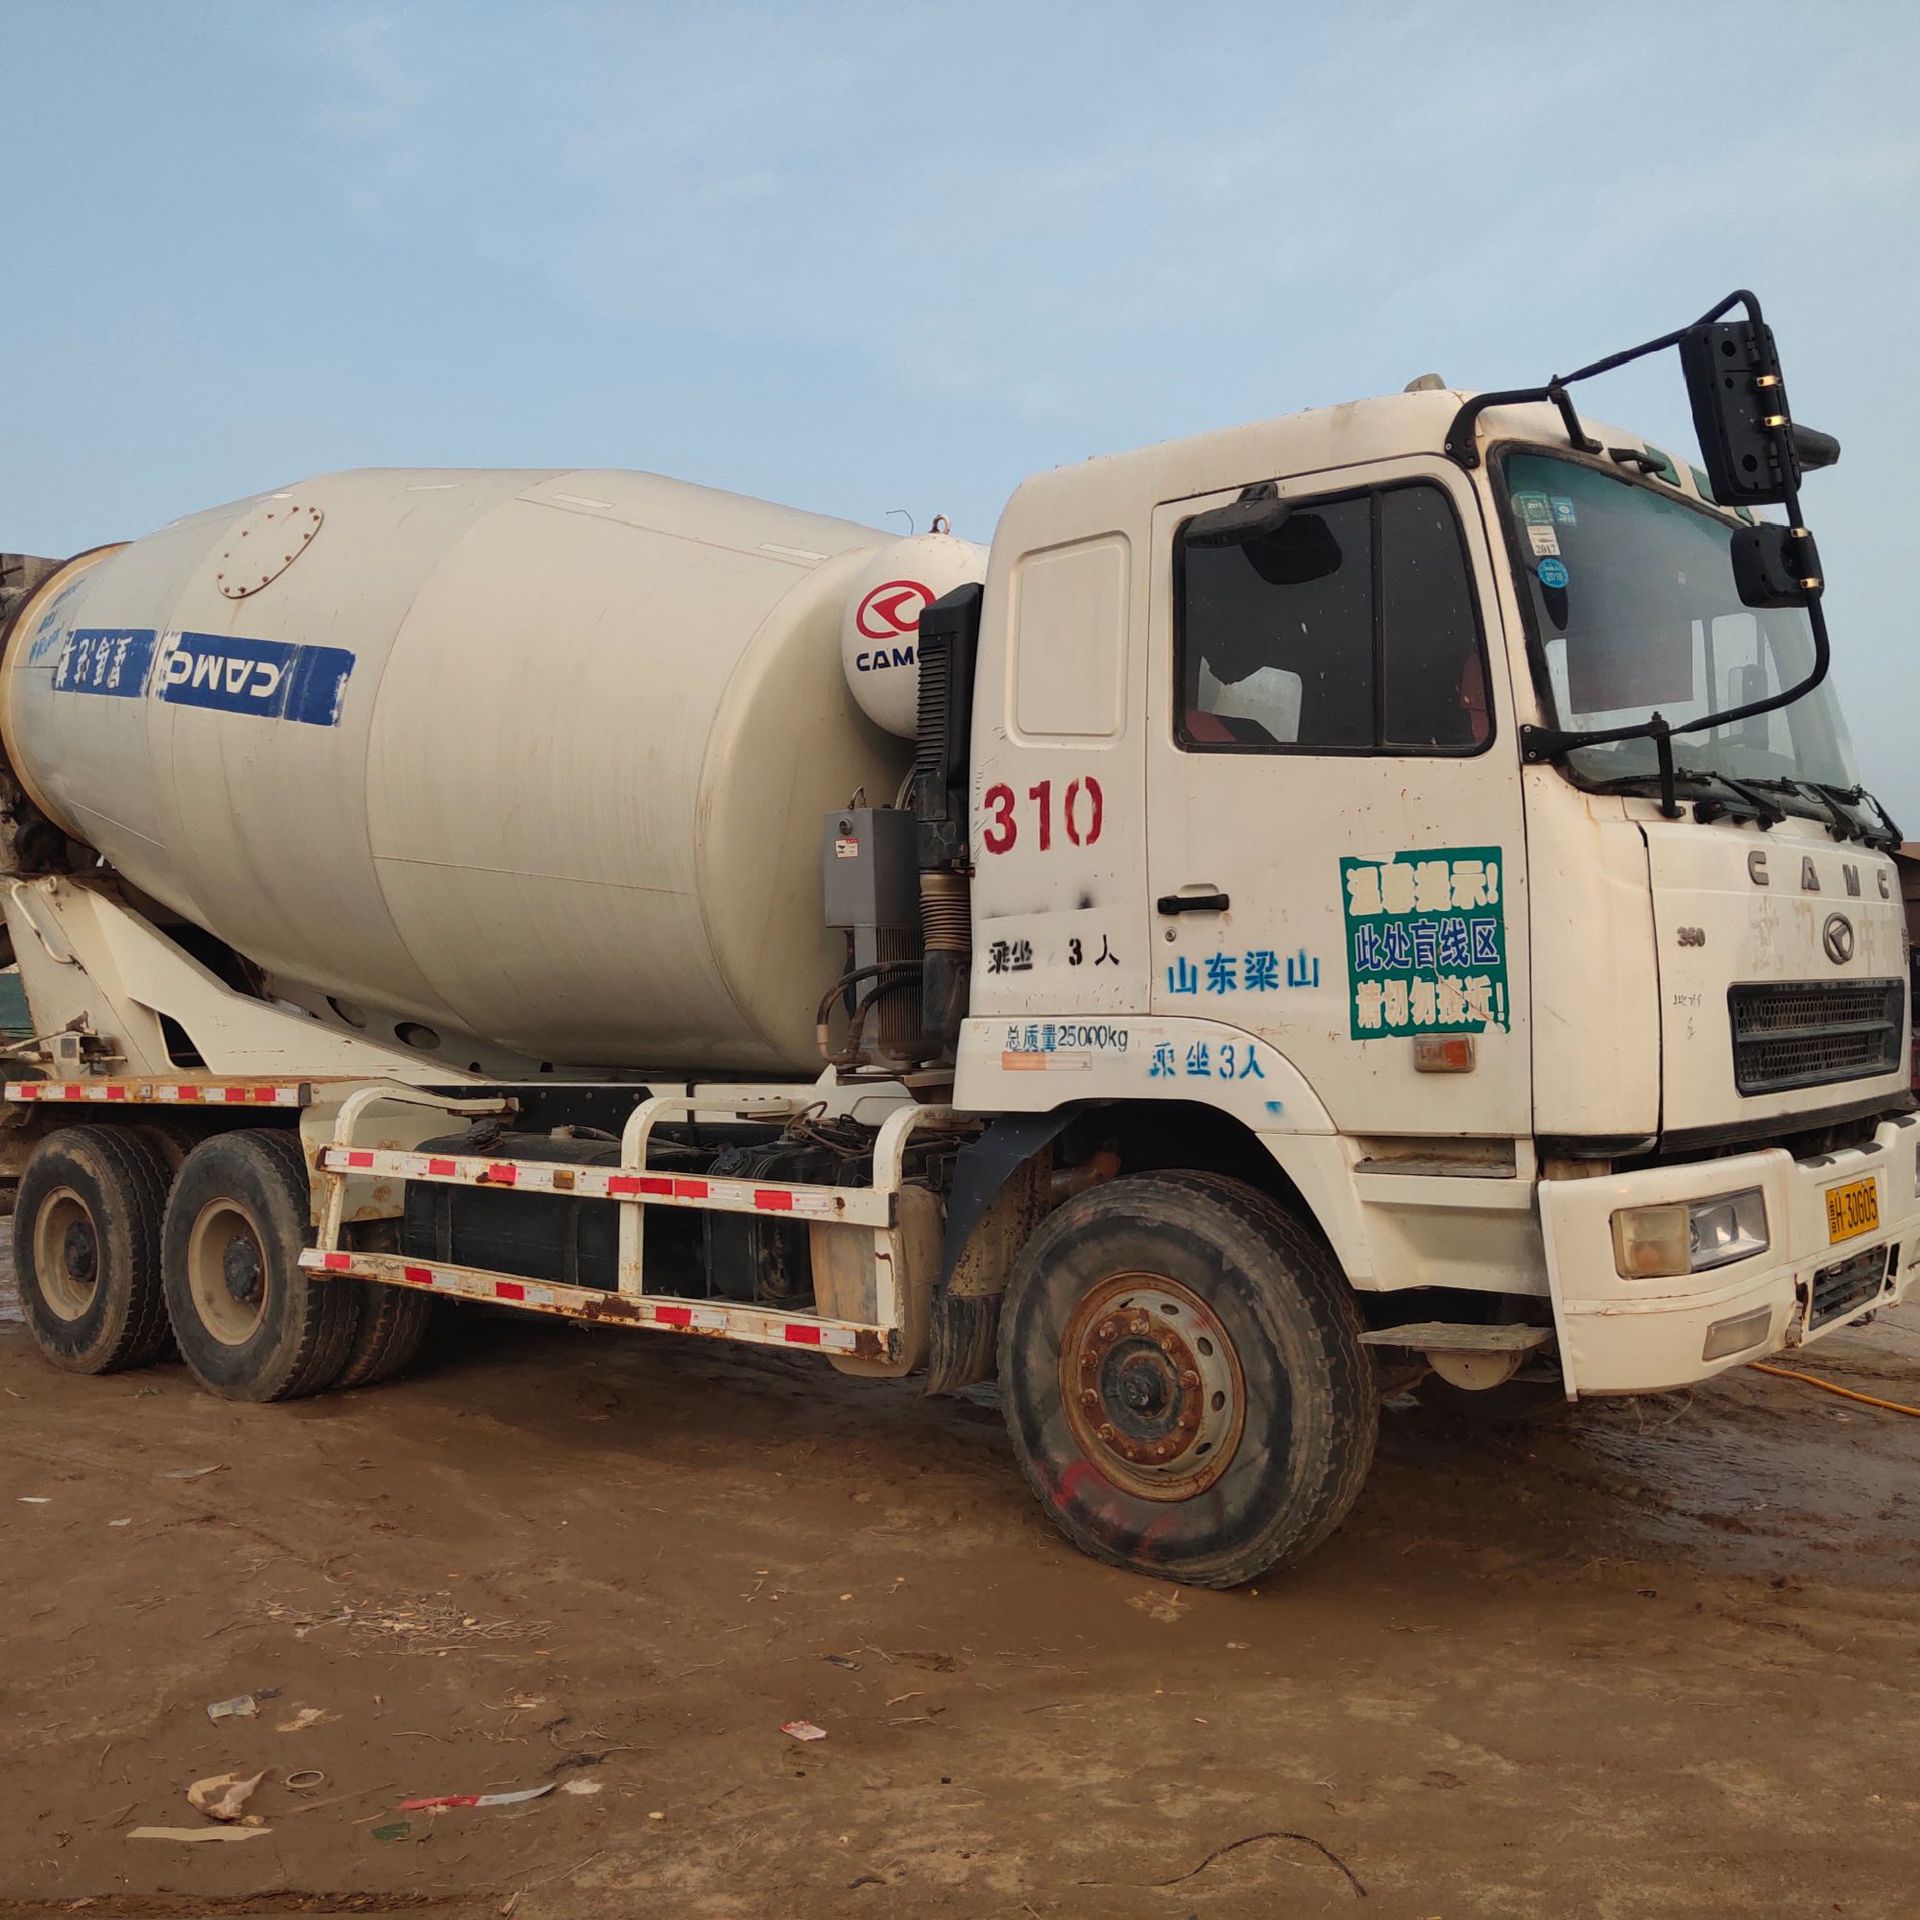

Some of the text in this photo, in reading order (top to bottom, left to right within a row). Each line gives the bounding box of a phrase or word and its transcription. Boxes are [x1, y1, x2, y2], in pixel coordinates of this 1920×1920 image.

[1535, 544, 1557, 554] 2017
[856, 646, 920, 671] CAM
[983, 776, 1103, 854] 310
[1748, 850, 1890, 899] CAMC
[1094, 934, 1119, 966] 人
[1355, 918, 1500, 972] 此处盲线区
[1168, 949, 1320, 995] 山东梁山
